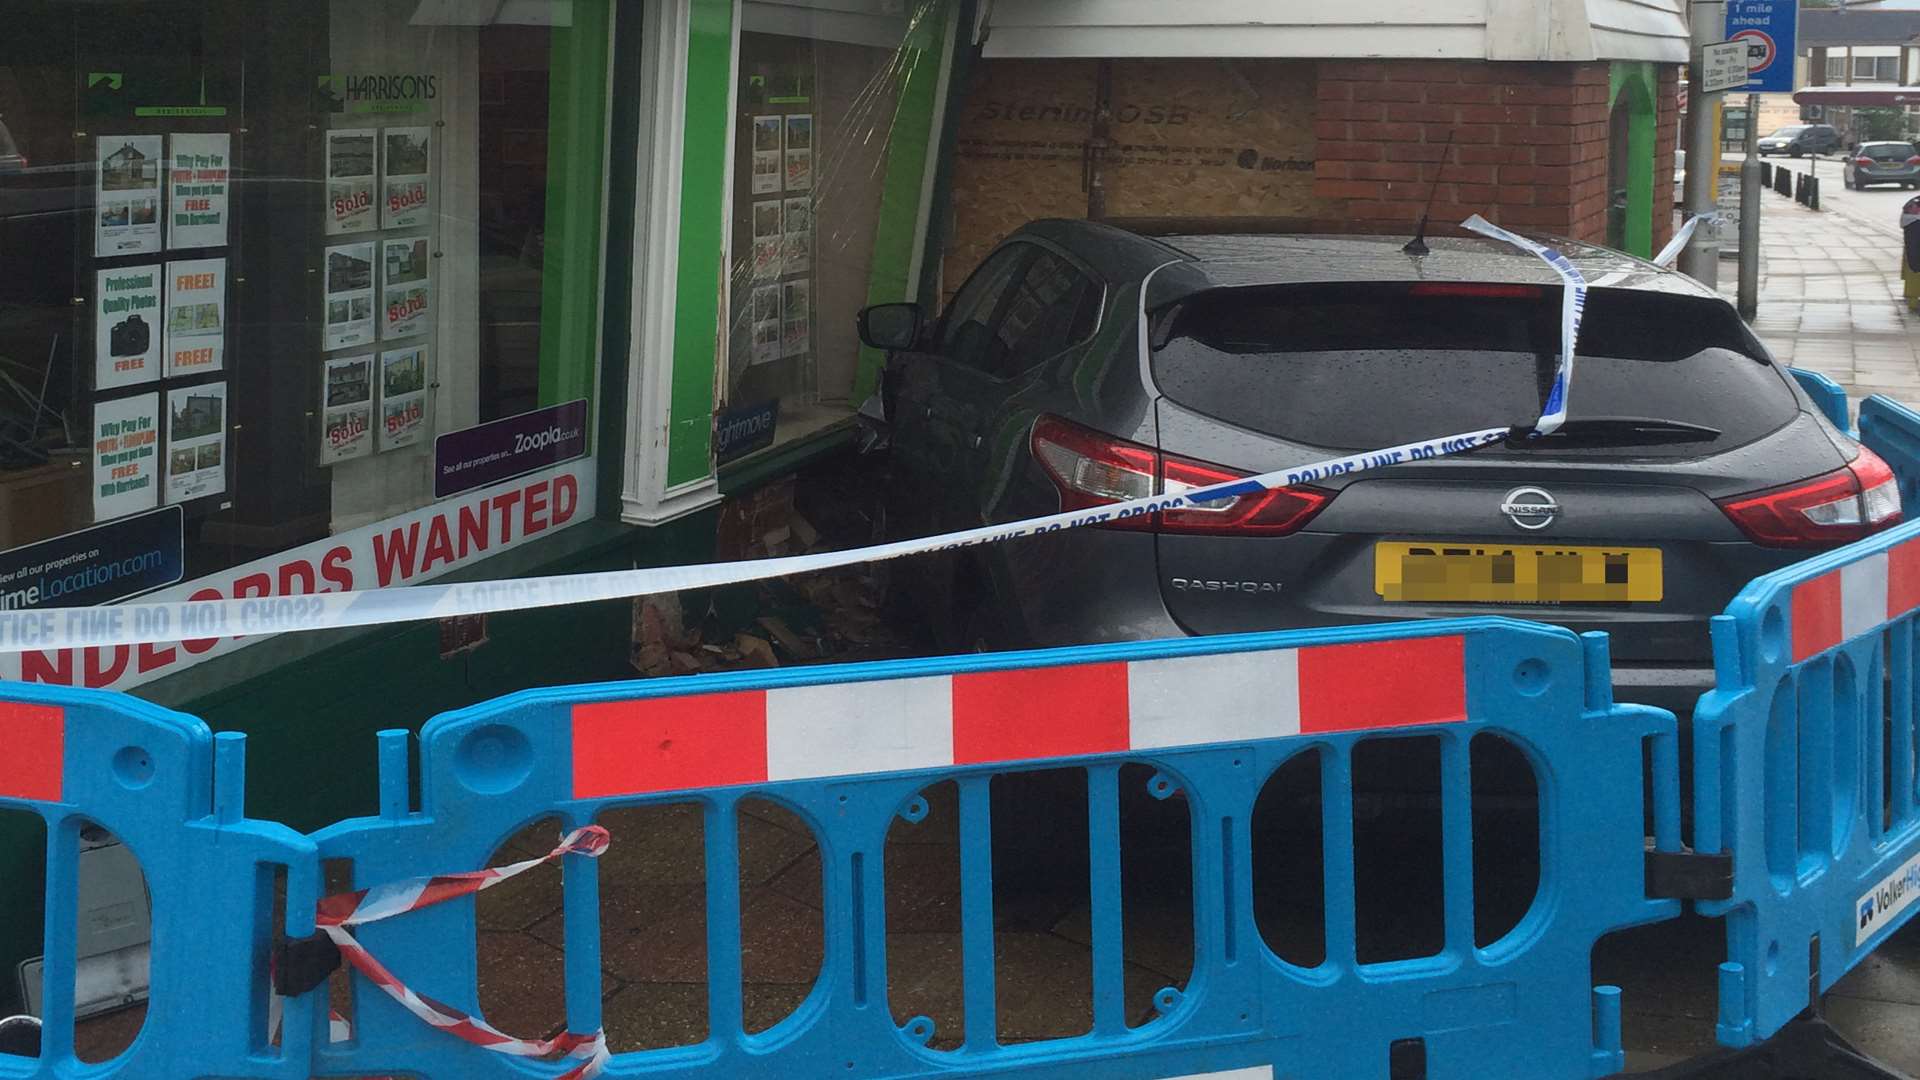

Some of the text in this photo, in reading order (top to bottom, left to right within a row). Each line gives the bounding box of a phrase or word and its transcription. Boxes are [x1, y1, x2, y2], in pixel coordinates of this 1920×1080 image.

[1746, 4, 1773, 13] mile
[1732, 16, 1770, 25] ahead
[346, 75, 436, 100] HARRISONS
[981, 101, 1091, 122] Sterlin
[336, 191, 368, 214] Sold
[391, 187, 424, 211] Sold
[106, 273, 153, 292] Professional
[177, 273, 216, 291] FREE!
[103, 294, 156, 314] Quality Photos
[114, 358, 144, 372] FREE
[175, 348, 213, 367] FREE!
[121, 420, 137, 433] Pay
[138, 416, 152, 429] For
[388, 404, 420, 432] Sold
[331, 417, 363, 444] Sold
[112, 464, 139, 480] FREE
[443, 464, 455, 475] See
[473, 452, 500, 468] properties
[1508, 505, 1557, 515] NISSAN
[372, 473, 578, 588] WANTED
[17, 566, 28, 578] all
[29, 564, 44, 575] our
[45, 552, 87, 574] properties
[88, 549, 100, 559] on
[1172, 578, 1283, 593] QASHQAI
[1876, 864, 1920, 914] VolkerHi
